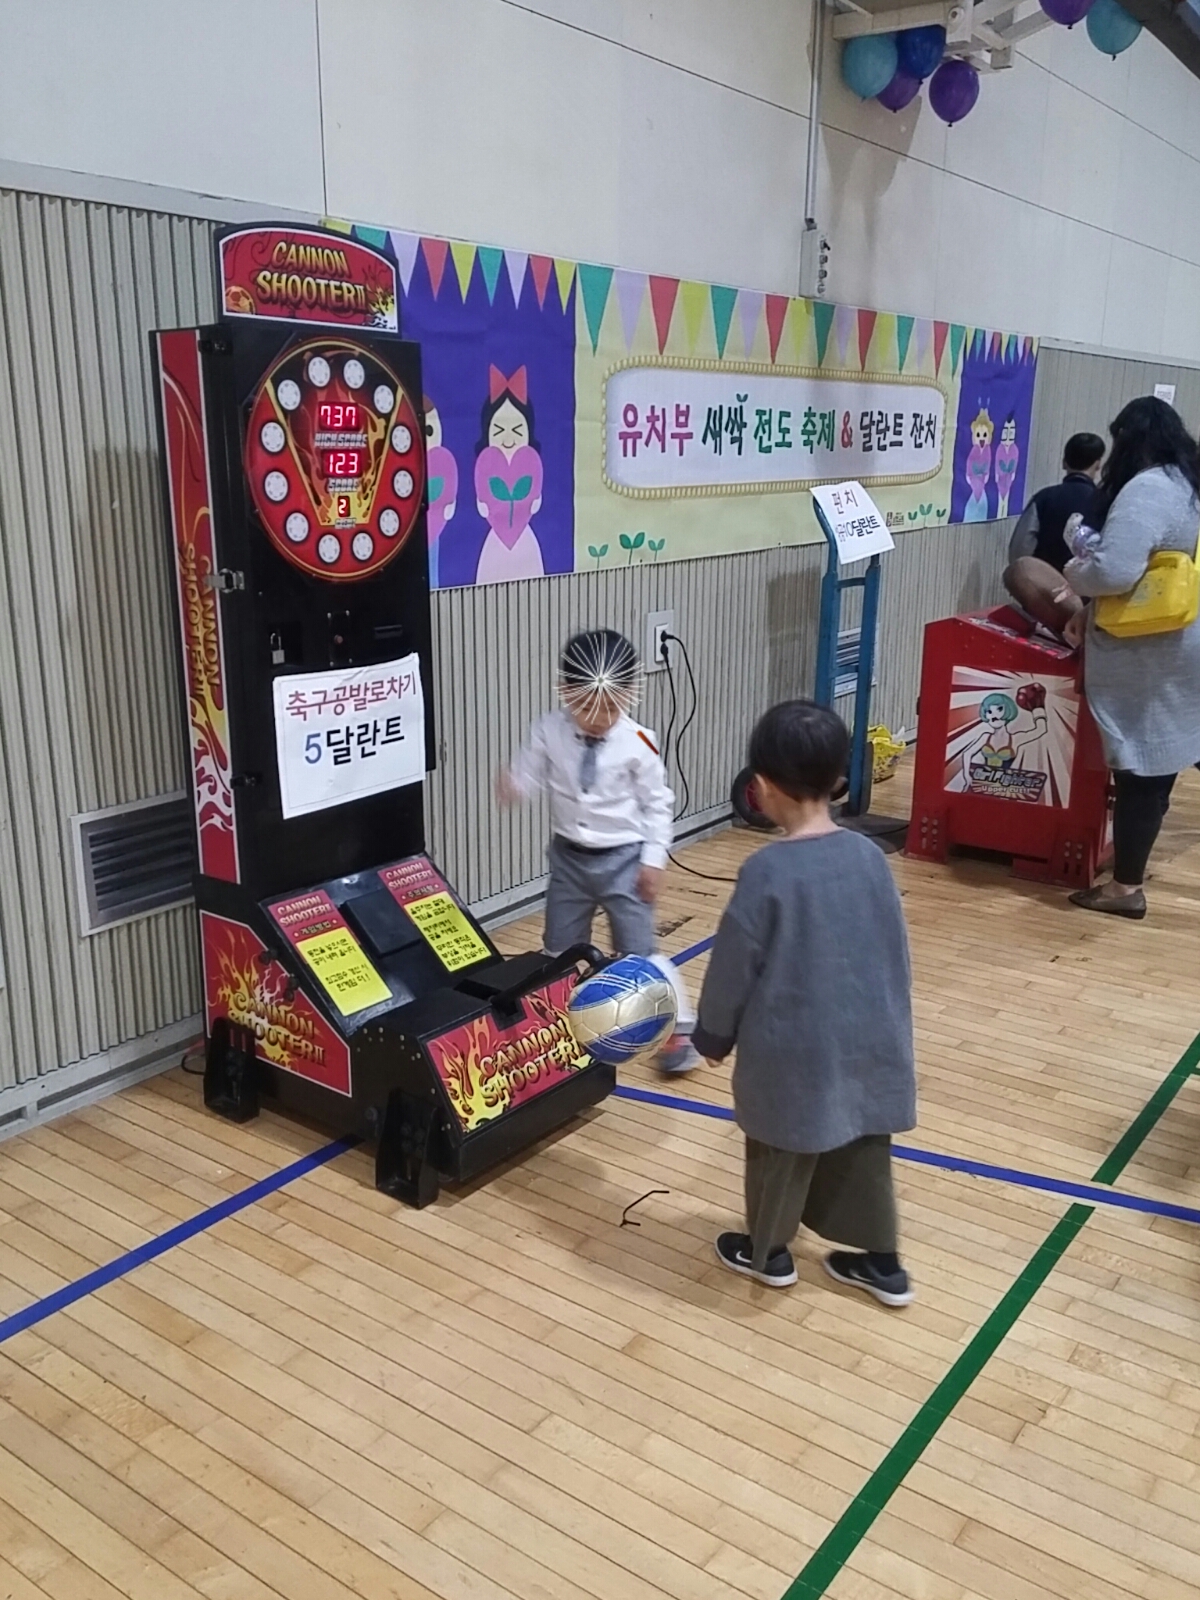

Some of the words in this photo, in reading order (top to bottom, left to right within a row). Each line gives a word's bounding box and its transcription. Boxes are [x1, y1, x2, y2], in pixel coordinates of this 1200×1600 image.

[271, 241, 350, 274] CANNON
[320, 405, 356, 428] 737
[314, 433, 338, 448] HIGH
[338, 433, 368, 448] SCORE
[618, 403, 694, 457] 유치부
[701, 403, 748, 456] 새싹
[753, 407, 793, 453] 전도
[800, 406, 836, 454] 축제
[840, 411, 854, 449] &
[859, 410, 905, 452] 달란트
[909, 412, 937, 448] 잔치
[329, 452, 359, 474] 123
[338, 498, 347, 514] 2
[304, 715, 405, 766] 5달란트
[385, 862, 424, 880] CANNON
[277, 895, 322, 915] CANNON
[234, 992, 315, 1040] CANNON
[479, 1018, 572, 1079] CANNON
